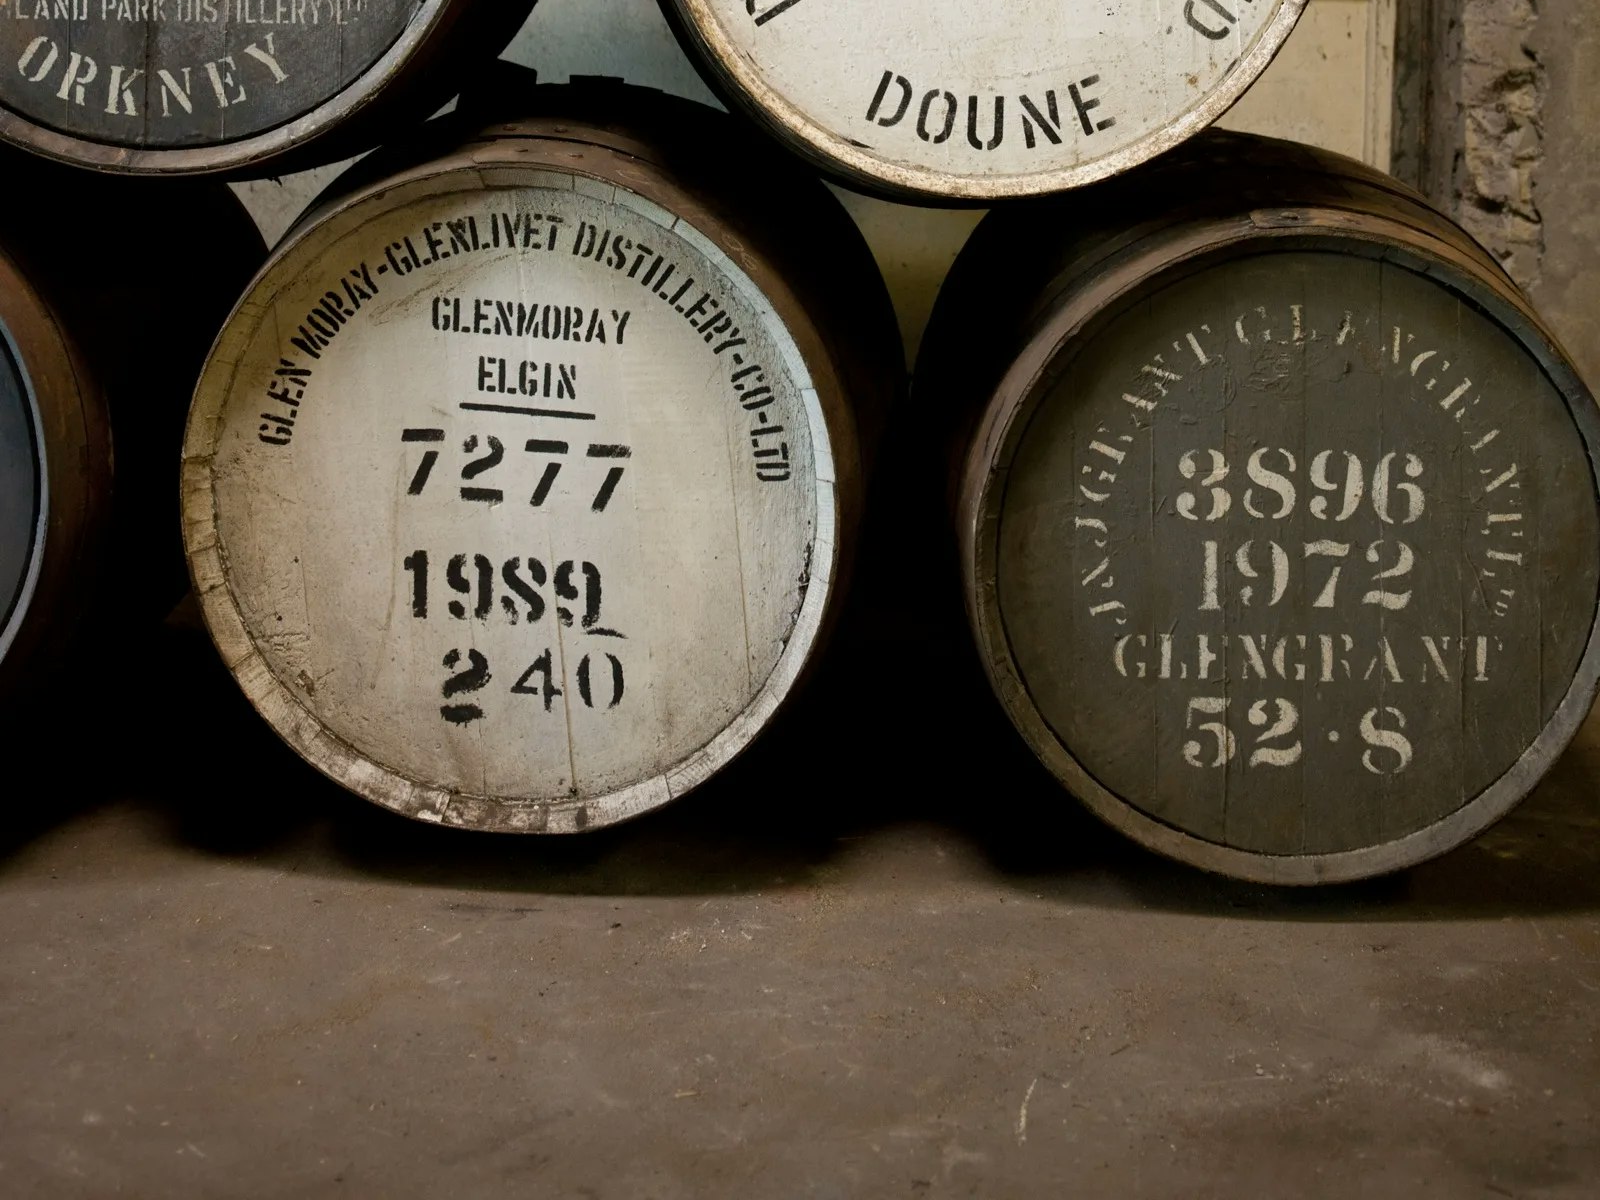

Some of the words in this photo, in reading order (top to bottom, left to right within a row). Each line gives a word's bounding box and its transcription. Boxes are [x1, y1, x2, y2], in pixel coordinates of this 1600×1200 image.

[17, 32, 290, 118] ORKNEY
[865, 70, 1117, 151] DOUNE
[432, 296, 632, 346] GLENMORAY
[258, 358, 312, 446] GLEN
[478, 356, 577, 401] ELGIN
[401, 428, 633, 514] 7277
[1176, 446, 1425, 524] 3896
[403, 549, 604, 629] 1989
[1198, 539, 1415, 610] 1972
[441, 647, 626, 727] 240
[1112, 633, 1503, 683] GLENGRANT
